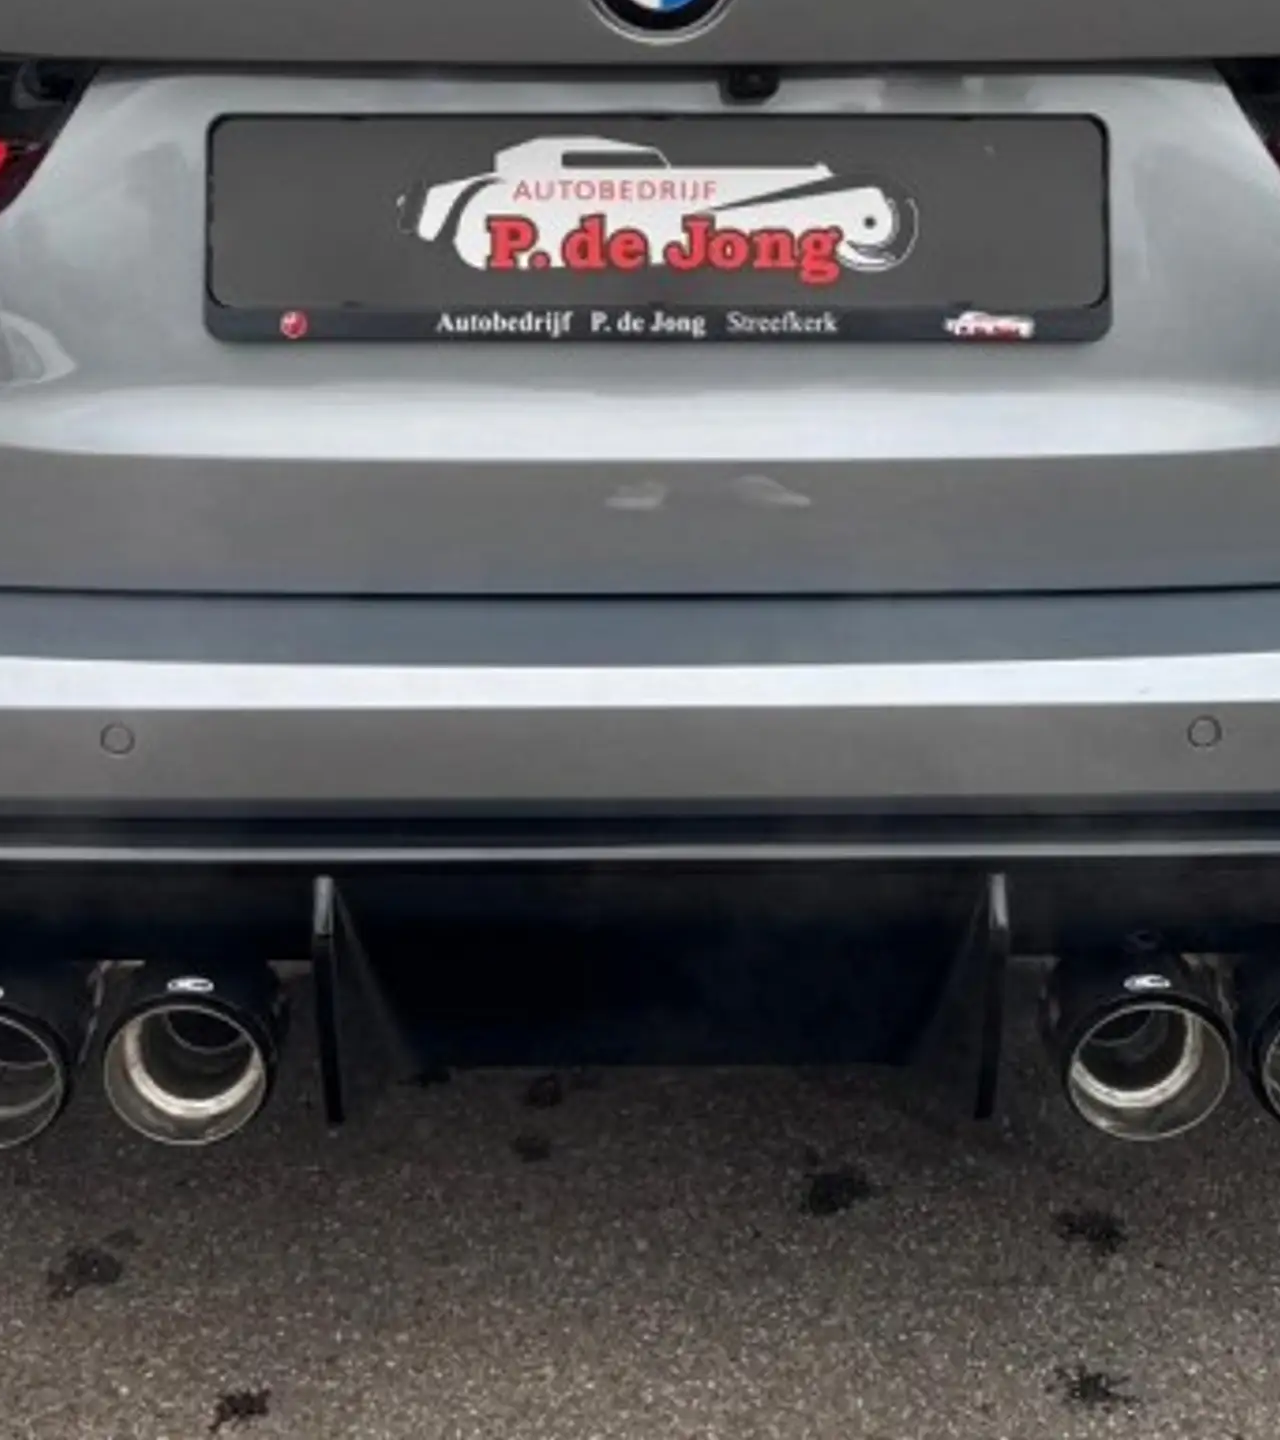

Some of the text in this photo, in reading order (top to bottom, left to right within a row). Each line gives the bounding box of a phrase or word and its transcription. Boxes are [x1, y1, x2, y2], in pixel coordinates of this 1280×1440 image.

[512, 178, 719, 201] AUTOBEDRIJF
[486, 213, 844, 285] P. de Jong
[436, 310, 839, 338] Autobedrijf P. de Jong Streefkerk
